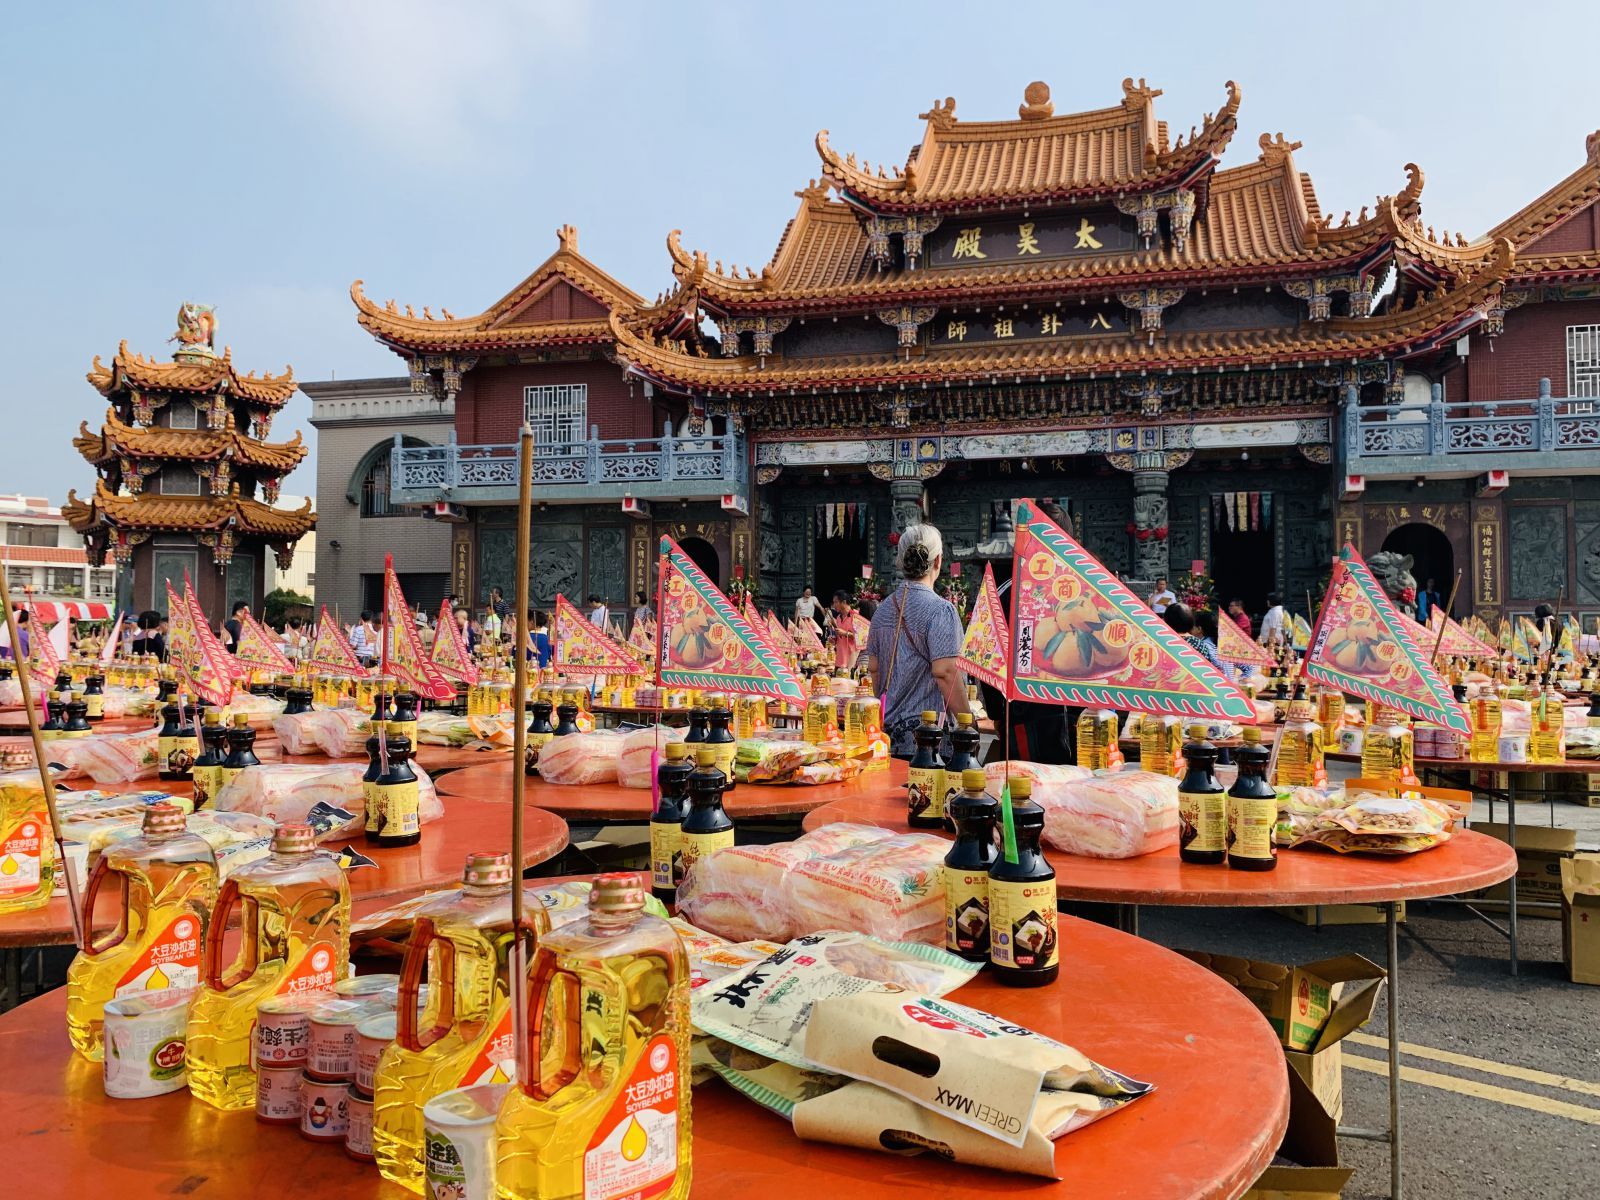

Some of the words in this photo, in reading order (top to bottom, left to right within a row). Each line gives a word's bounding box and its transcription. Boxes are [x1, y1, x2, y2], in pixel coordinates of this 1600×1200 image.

[951, 217, 1103, 260] 太昊殿
[947, 312, 1112, 342] 八卦祖師
[150, 938, 197, 960] 大豆沙拉油
[150, 953, 184, 966] SOYBEAN
[186, 951, 197, 959] OIL
[287, 970, 333, 992] 大豆沙拉油
[625, 1070, 675, 1105] 大豆沙拉油
[625, 1094, 662, 1114] SOYBEAN
[663, 1089, 675, 1101] OIL
[935, 1086, 1022, 1135] GREENMAX
